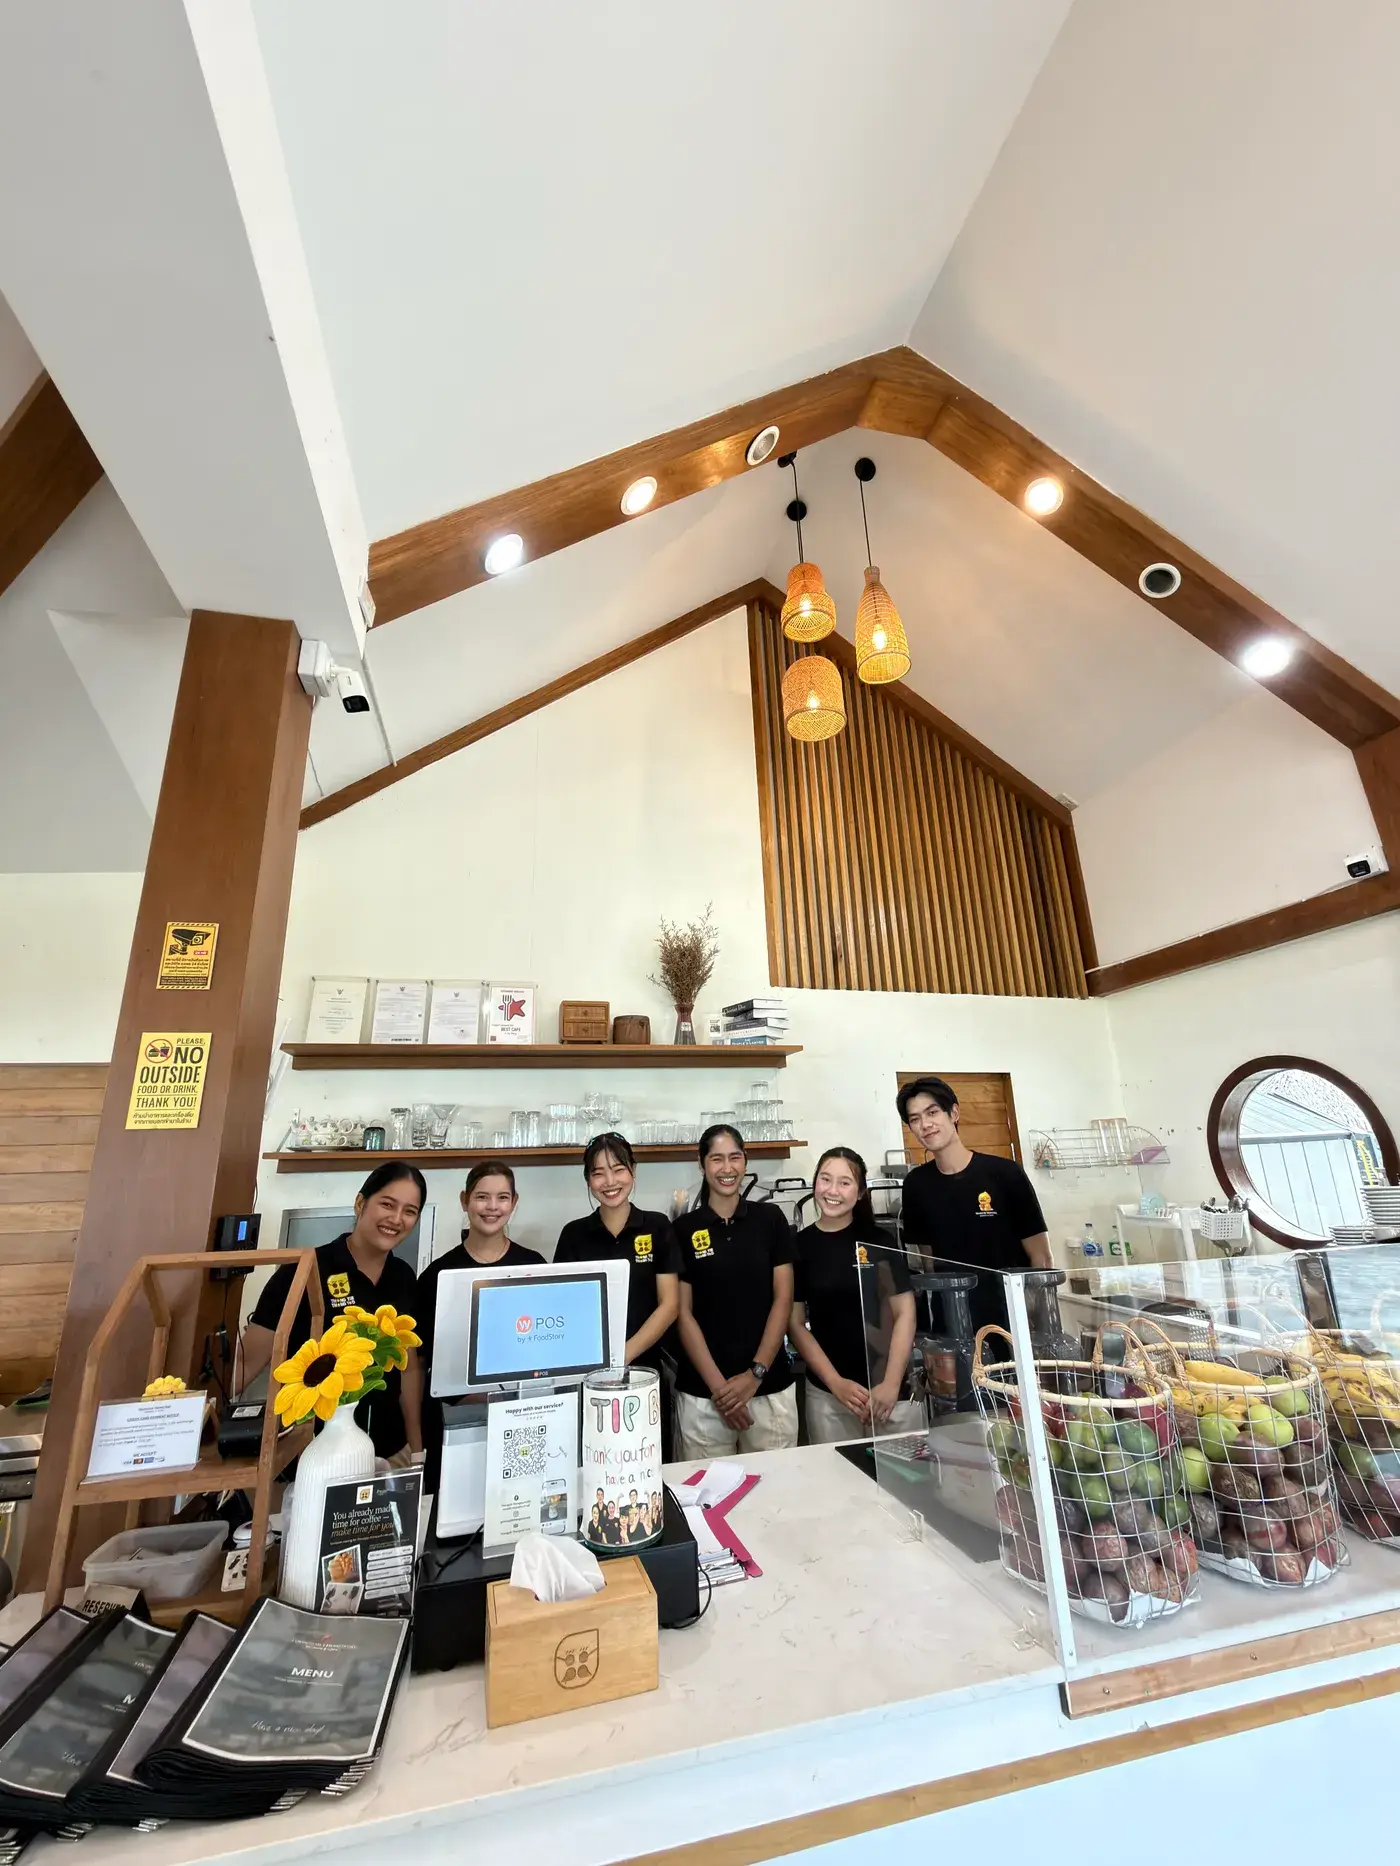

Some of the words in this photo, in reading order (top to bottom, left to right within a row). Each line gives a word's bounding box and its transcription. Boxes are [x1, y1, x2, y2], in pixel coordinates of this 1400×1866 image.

[176, 1037, 206, 1045] PLEASE,
[173, 1046, 204, 1064] NO
[139, 1066, 202, 1084] OUTSIDE
[137, 1085, 158, 1094] FOOD
[160, 1085, 171, 1094] OR
[136, 1097, 169, 1108] THANK
[173, 1096, 197, 1107] YOU!
[535, 1315, 565, 1330] POS
[517, 1336, 526, 1344] by
[533, 1333, 565, 1341] FoodStory
[590, 1395, 641, 1434] TIP
[614, 1448, 638, 1473] you
[639, 1436, 656, 1461] for
[628, 1473, 636, 1484] a
[333, 1511, 347, 1520] You
[348, 1507, 374, 1518] already
[375, 1503, 391, 1514] mad
[332, 1520, 348, 1529] time
[350, 1517, 360, 1527] for
[361, 1514, 381, 1524] coffee
[331, 1527, 352, 1538] make
[352, 1525, 369, 1534] time
[367, 1523, 380, 1534] for
[82, 1599, 126, 1614] RESERV
[291, 1666, 334, 1678] MENU
